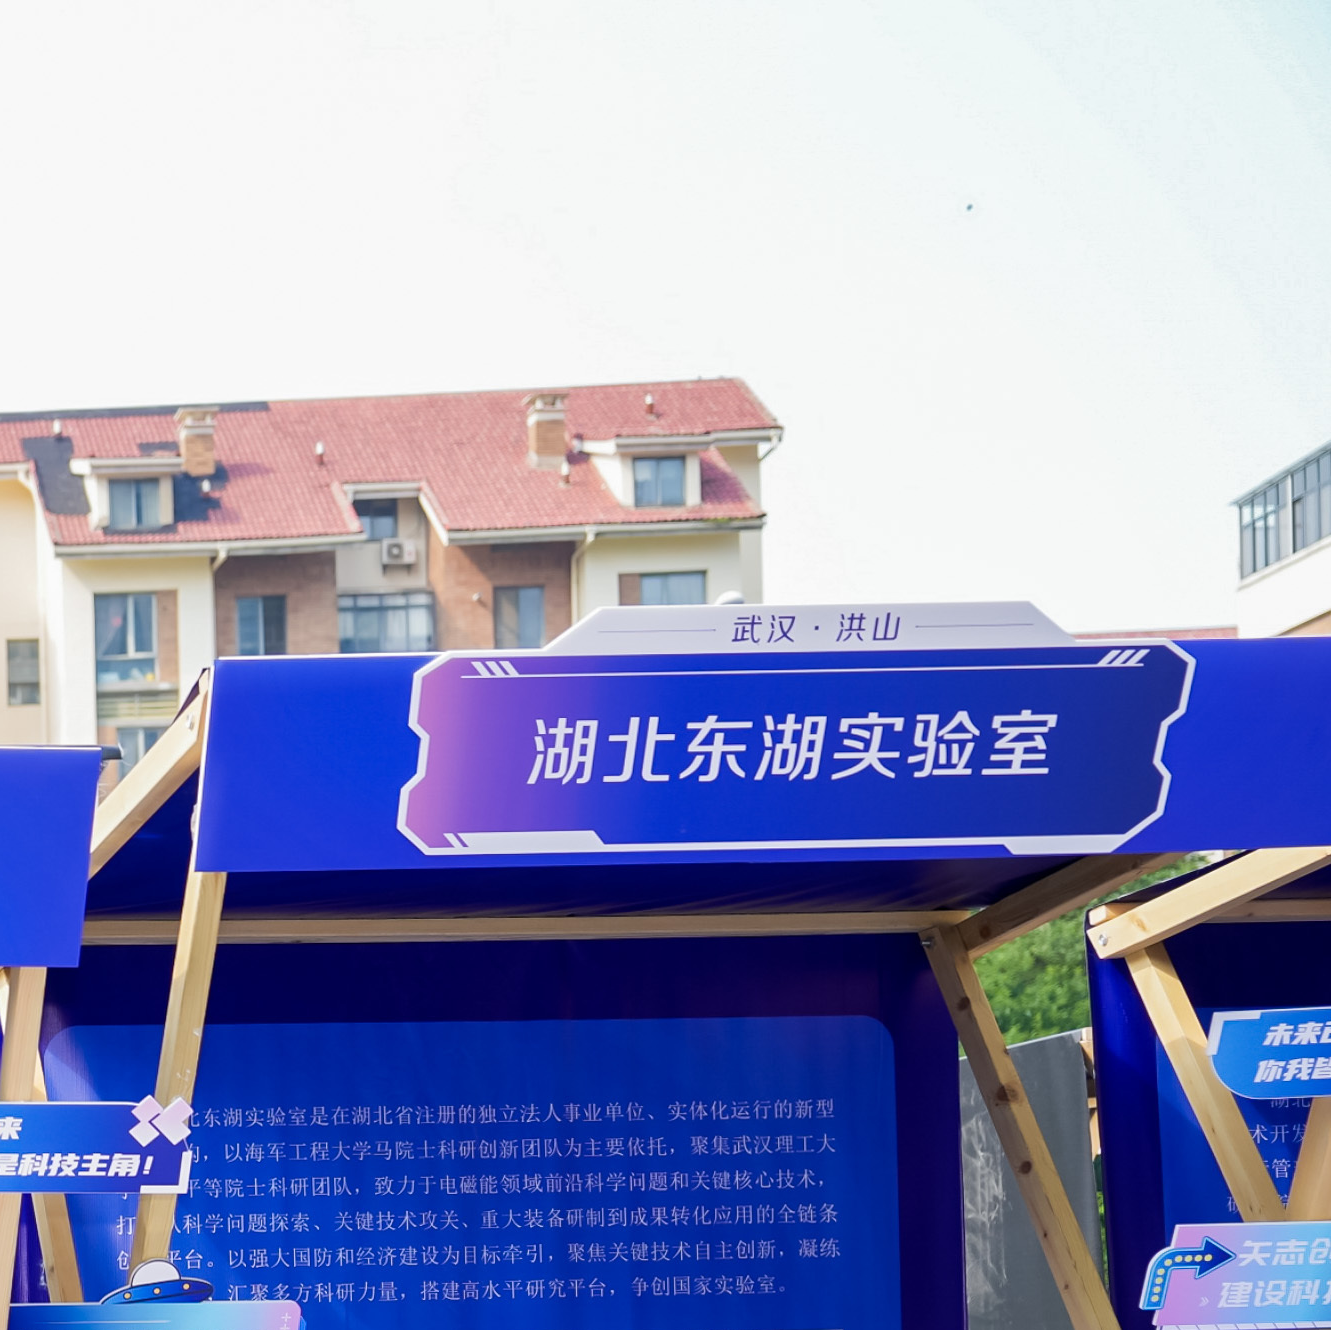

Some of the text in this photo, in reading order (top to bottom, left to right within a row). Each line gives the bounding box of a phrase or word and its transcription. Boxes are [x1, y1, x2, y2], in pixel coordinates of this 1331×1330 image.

[527, 709, 1061, 787] 湖北东湖实验室
